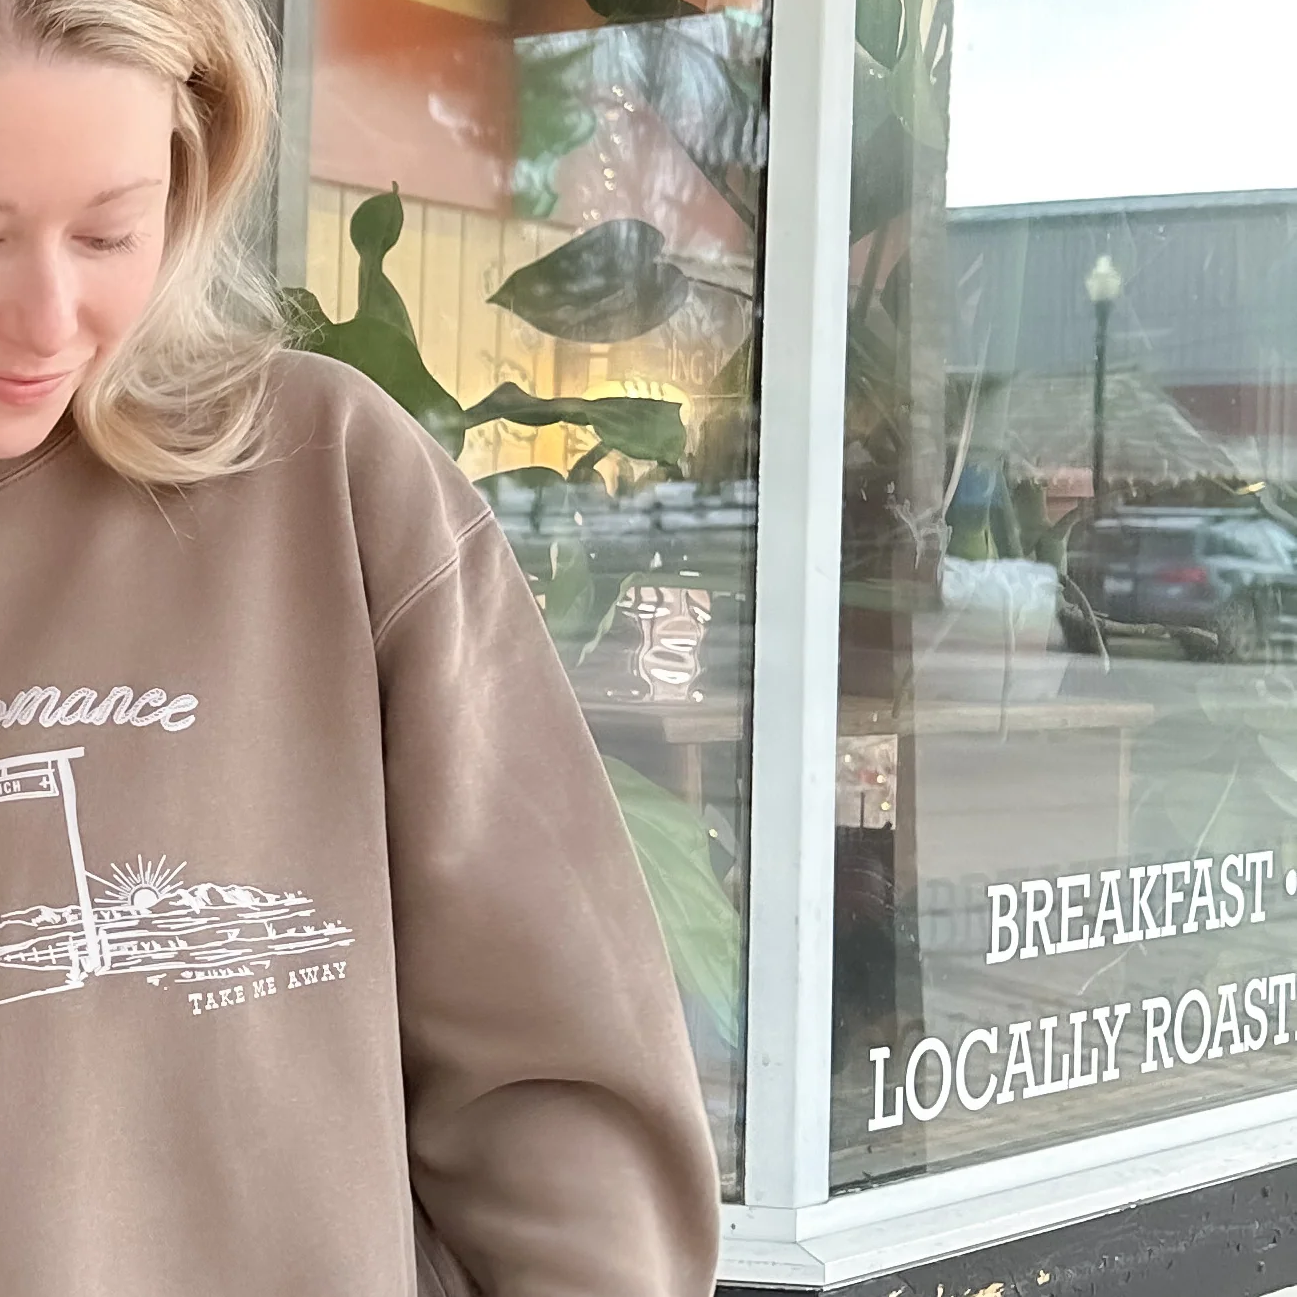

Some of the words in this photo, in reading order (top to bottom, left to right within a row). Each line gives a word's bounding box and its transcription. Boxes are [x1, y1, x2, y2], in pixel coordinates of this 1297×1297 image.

[985, 849, 1275, 965] BREAKFAST
[187, 985, 246, 1015] TAKE
[252, 976, 277, 999] ME
[287, 961, 347, 989] AWAY
[868, 1002, 1132, 1132] LOCALLY
[1140, 972, 1297, 1074] ROAST
